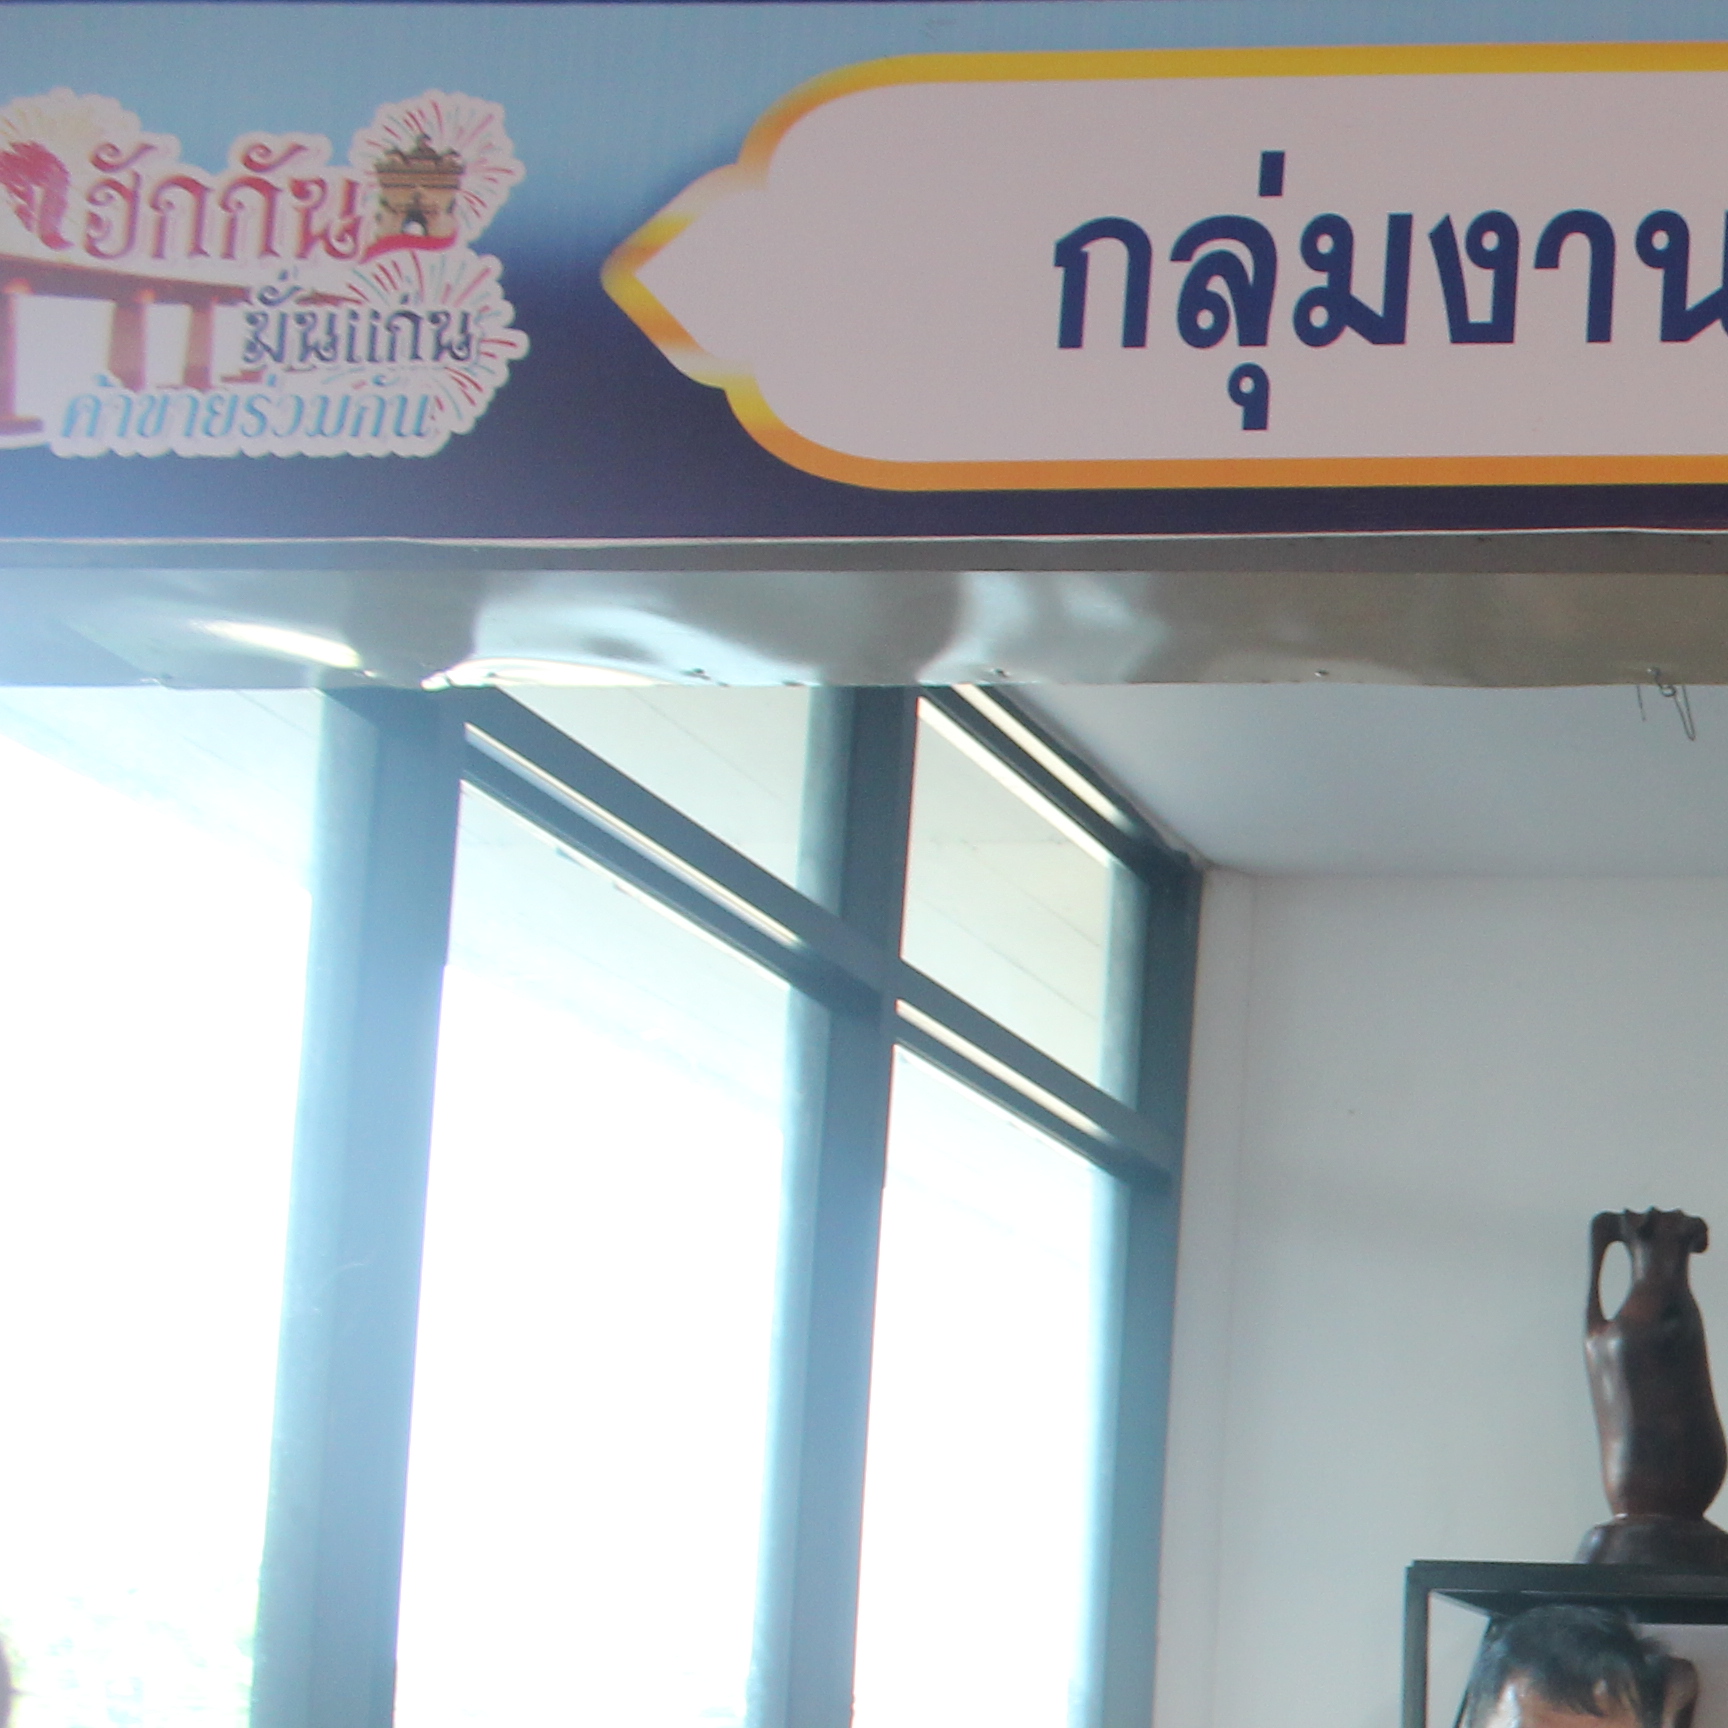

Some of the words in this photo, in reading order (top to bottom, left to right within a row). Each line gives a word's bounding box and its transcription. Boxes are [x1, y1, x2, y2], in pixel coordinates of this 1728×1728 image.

[84, 142, 366, 260] ฮักกัน
[242, 268, 476, 365] มั่นแก่น
[59, 373, 432, 440] ค้าขายร่วมกัน
